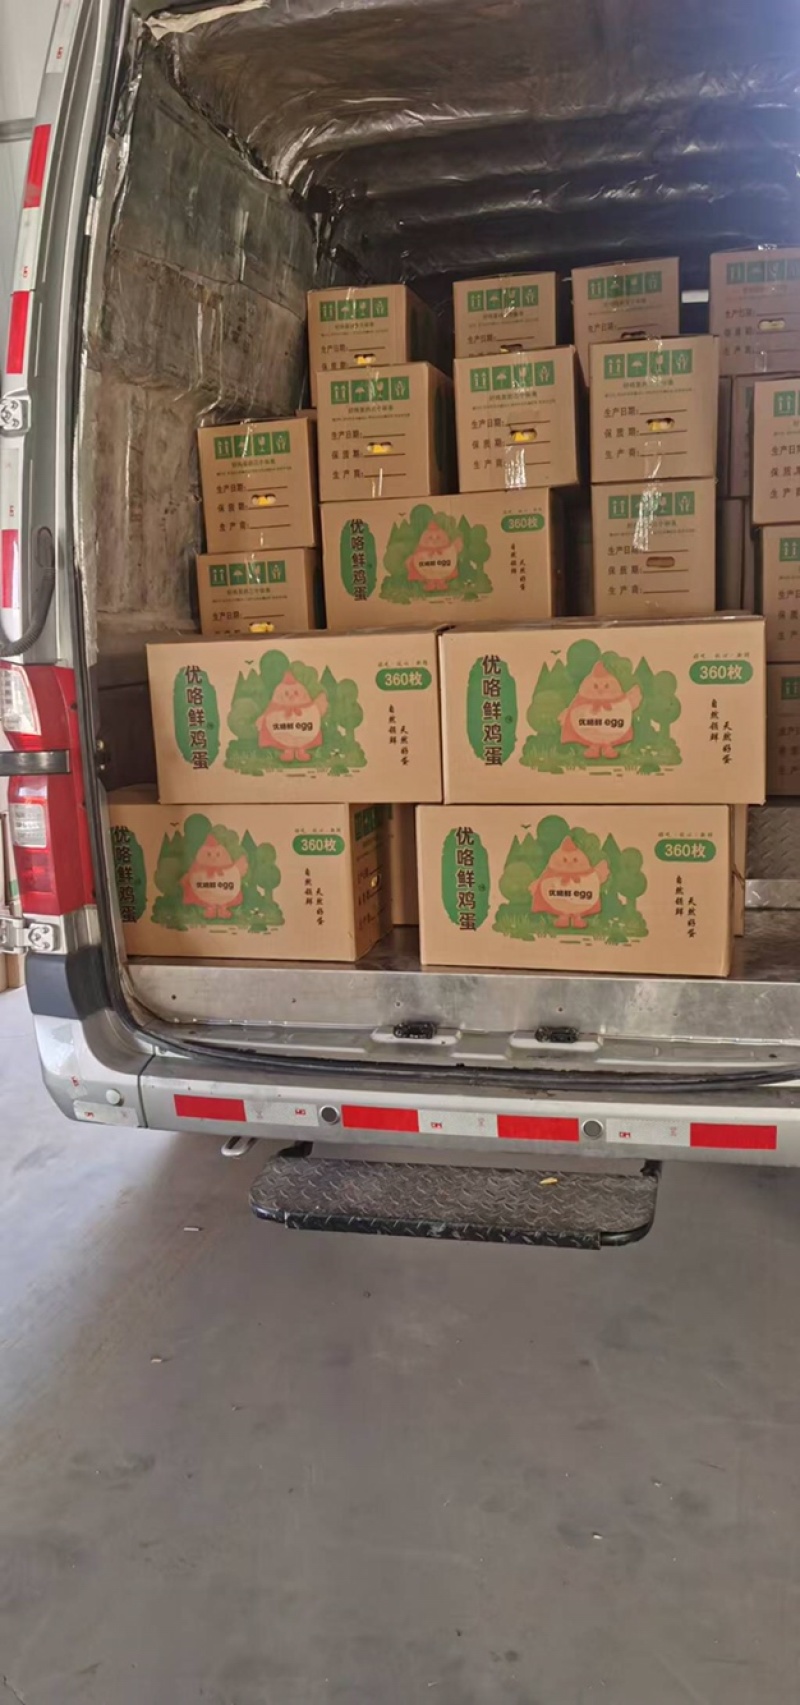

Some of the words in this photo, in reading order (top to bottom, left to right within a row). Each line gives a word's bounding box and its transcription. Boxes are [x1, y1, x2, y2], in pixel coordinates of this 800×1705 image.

[508, 517, 538, 530] 360枚
[351, 518, 367, 600] 优咯鲜鸡蛋
[437, 558, 451, 567] egg
[384, 671, 424, 687] 360枚
[700, 664, 742, 680] 360枚
[186, 665, 209, 770] 优咯鲜鸡蛋
[482, 655, 503, 766] 优咯鲜鸡蛋
[295, 721, 313, 732] egg
[604, 718, 624, 729] egg
[300, 838, 337, 852] 360枚
[664, 843, 706, 859] 360枚
[113, 825, 137, 923] 优咯鲜鸡蛋
[456, 827, 477, 931] 优咯鲜鸡蛋
[217, 882, 235, 891] egg
[573, 890, 593, 900] egg
